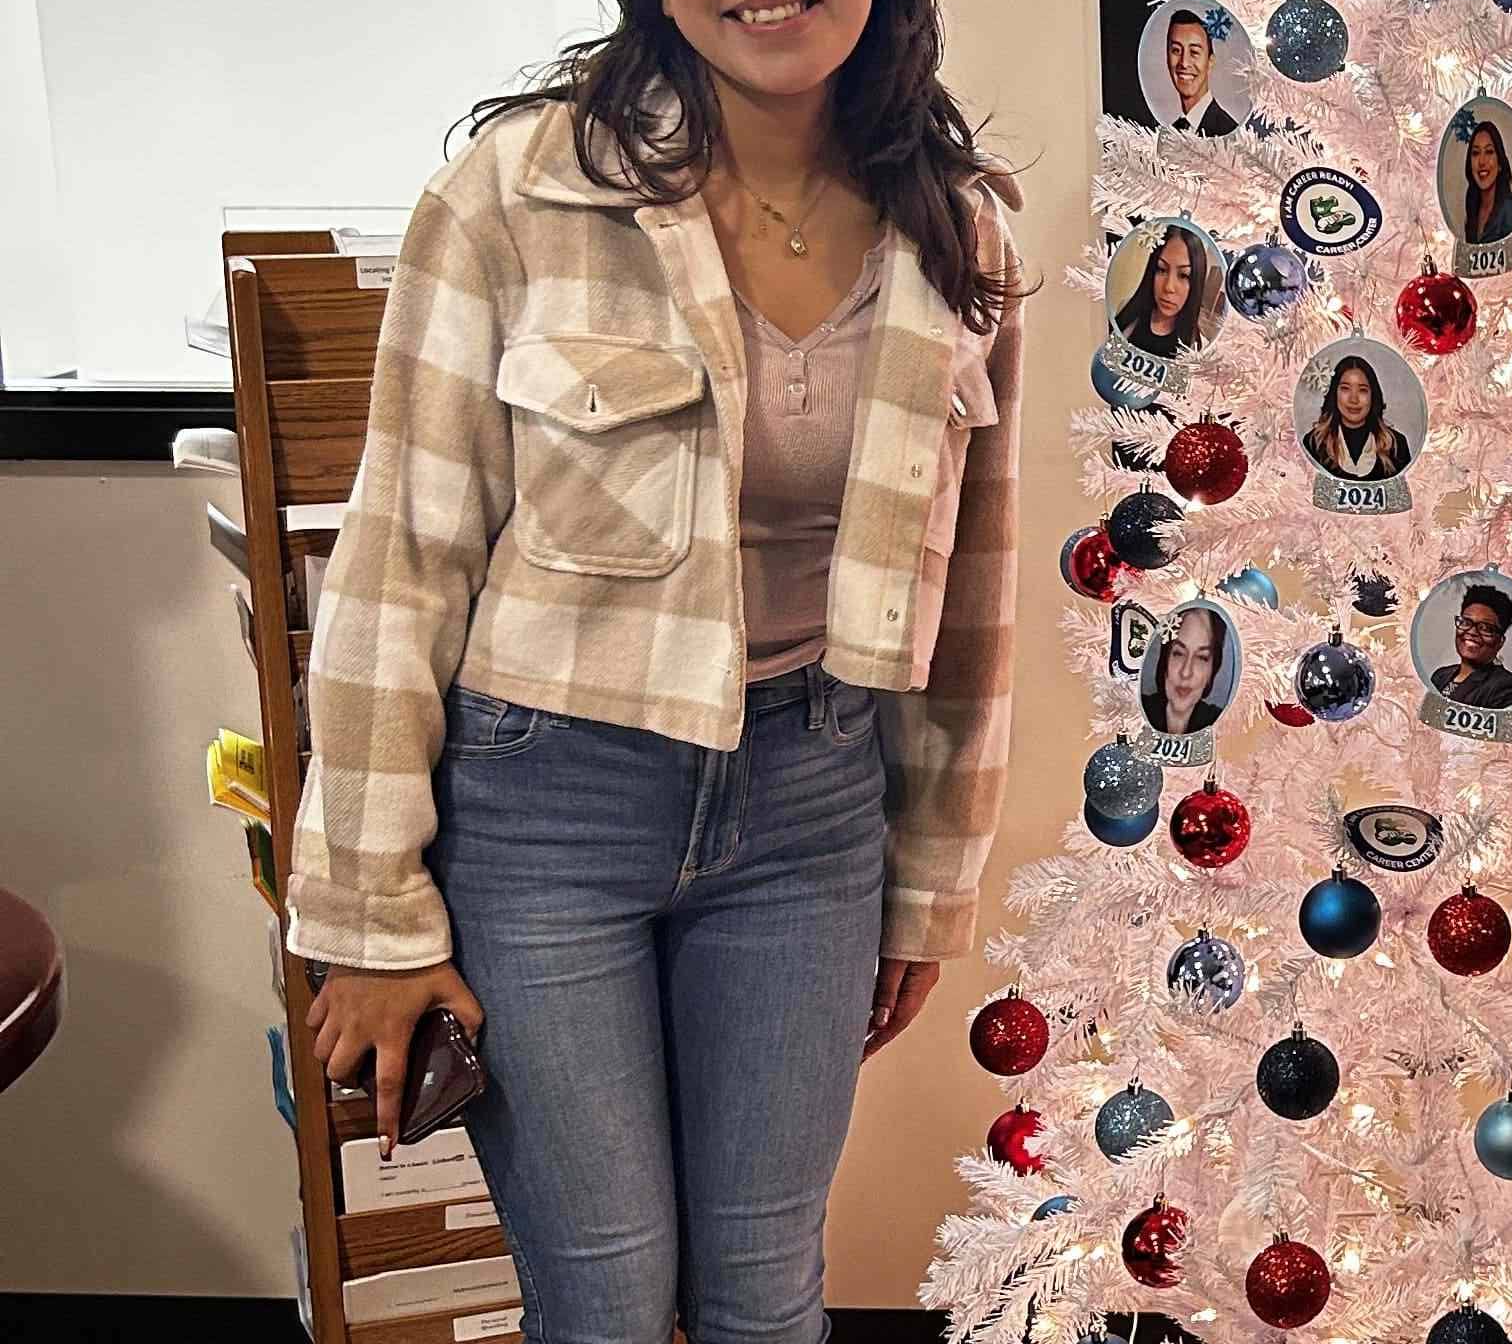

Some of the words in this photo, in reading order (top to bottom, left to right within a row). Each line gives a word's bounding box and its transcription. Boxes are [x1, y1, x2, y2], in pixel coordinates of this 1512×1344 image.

[1288, 171, 1318, 196] CAREER
[1315, 241, 1357, 254] CAREER
[1471, 250, 1505, 271] 2024
[1121, 350, 1166, 385] 2024
[1337, 486, 1385, 508] 2024
[1444, 707, 1496, 735] 2024
[1151, 739, 1190, 761] 2024
[1366, 850, 1404, 869] CAREER
